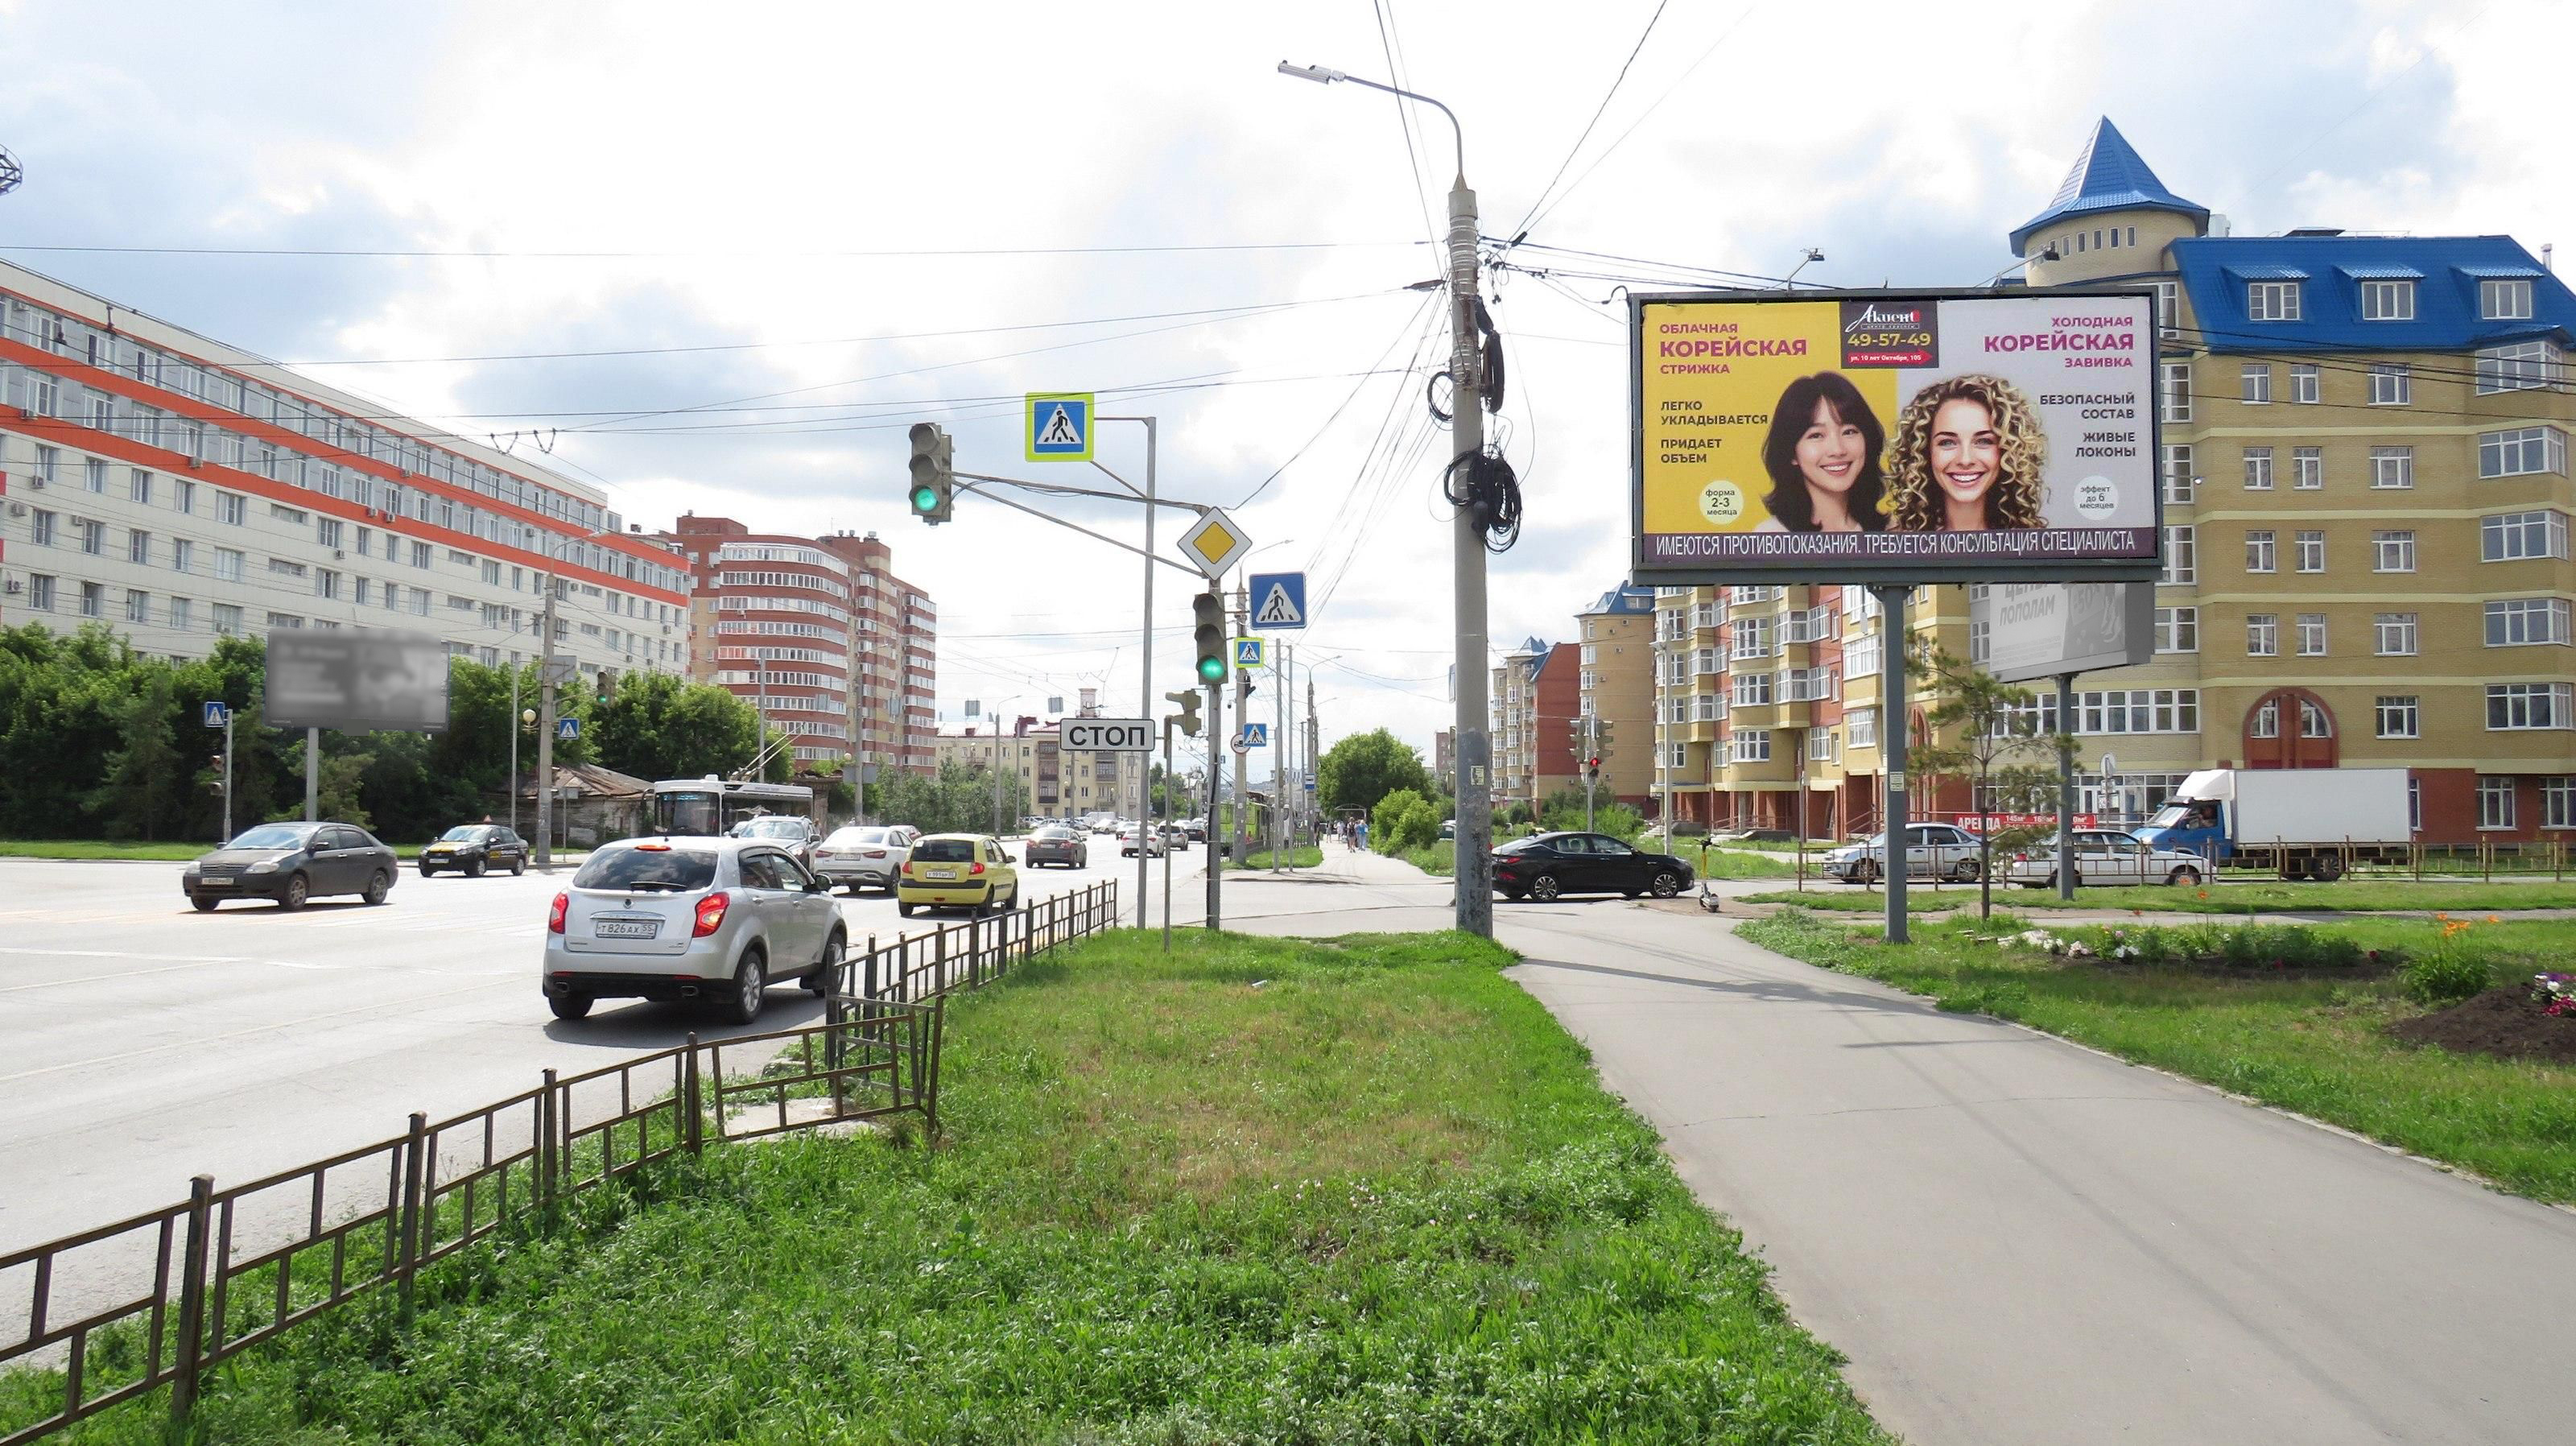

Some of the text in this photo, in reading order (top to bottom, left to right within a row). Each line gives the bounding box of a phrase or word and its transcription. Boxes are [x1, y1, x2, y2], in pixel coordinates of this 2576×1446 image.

[2052, 316, 2133, 328] ХОЛОДНАЯ
[1660, 324, 1738, 334] ОБЛАЧНАЯ
[1847, 333, 1931, 346] 49-57-49
[1984, 330, 2134, 353] КОРЕЙСКАЯ
[1660, 336, 1807, 357] КОРЕЙСКАЯ
[2065, 357, 2133, 368] ЗАВИВКА
[1660, 364, 1731, 374] СТРИЖКА
[2040, 391, 2135, 405] БЕЗОПАСНЫЙ
[1661, 401, 1703, 411] ЛЕГКО
[2081, 409, 2134, 419] СОСТАВ
[1661, 415, 1769, 426] УКЛАДЫВАЕТСЯ
[2083, 432, 2136, 443] ЖИВЫЕ
[1661, 439, 1722, 450] ПРИДАЕТ
[2075, 447, 2136, 457] ЛОКОНЫ
[1661, 454, 1707, 464] ОБЪЕМ
[1706, 489, 1736, 497] форма
[2080, 485, 2111, 494] эффект
[1711, 498, 1730, 507] 2-3
[2098, 493, 2105, 502] 6
[1657, 530, 2135, 556] ИМЕЮТСЯ ПРОТИВОПОКАЗАНИЯ. ТРЕБУЕТСЯ КОНСУЛЬТАЦИЯ СПЕЦИАЛИСТА
[2004, 584, 2048, 601] ЦЕ
[1999, 594, 2056, 626] ПОПОЛАМ
[1069, 726, 1145, 746] СТОП
